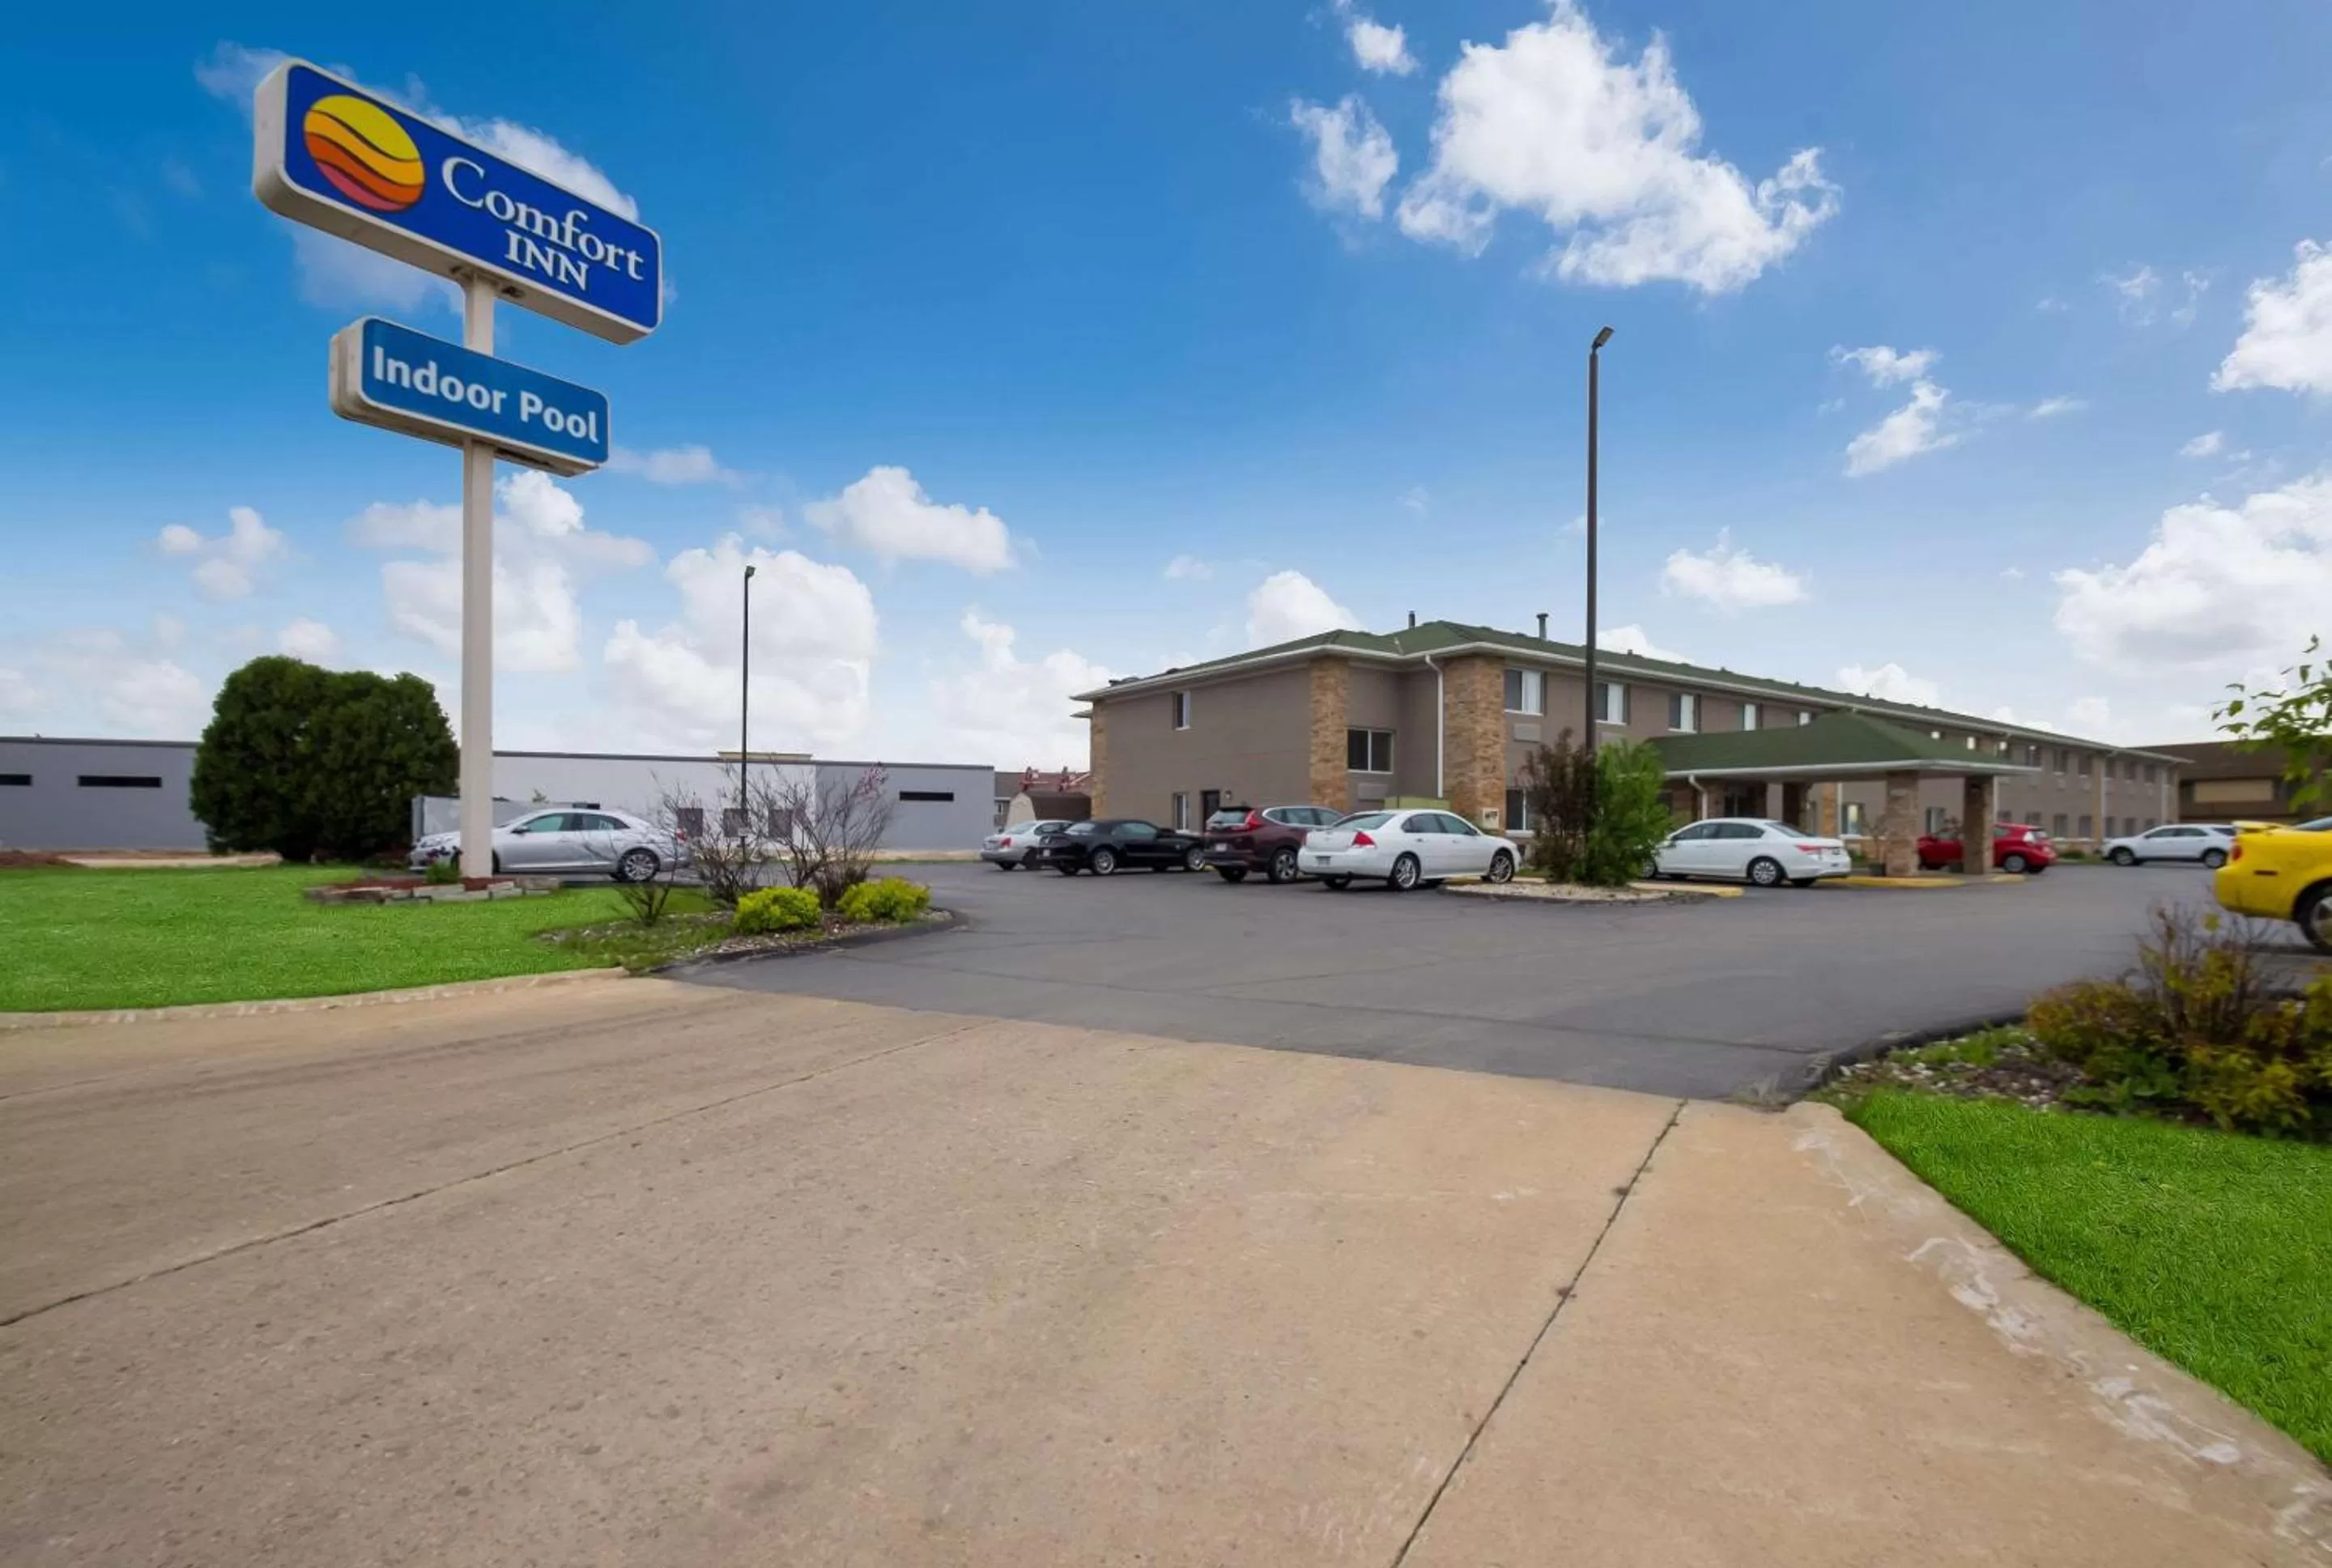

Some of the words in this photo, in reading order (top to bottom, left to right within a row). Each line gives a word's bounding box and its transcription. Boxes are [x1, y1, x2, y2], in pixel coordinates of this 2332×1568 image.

[442, 157, 645, 281] Comfort
[504, 229, 589, 291] INN
[372, 345, 507, 414] Indoor
[520, 390, 598, 444] Pool
